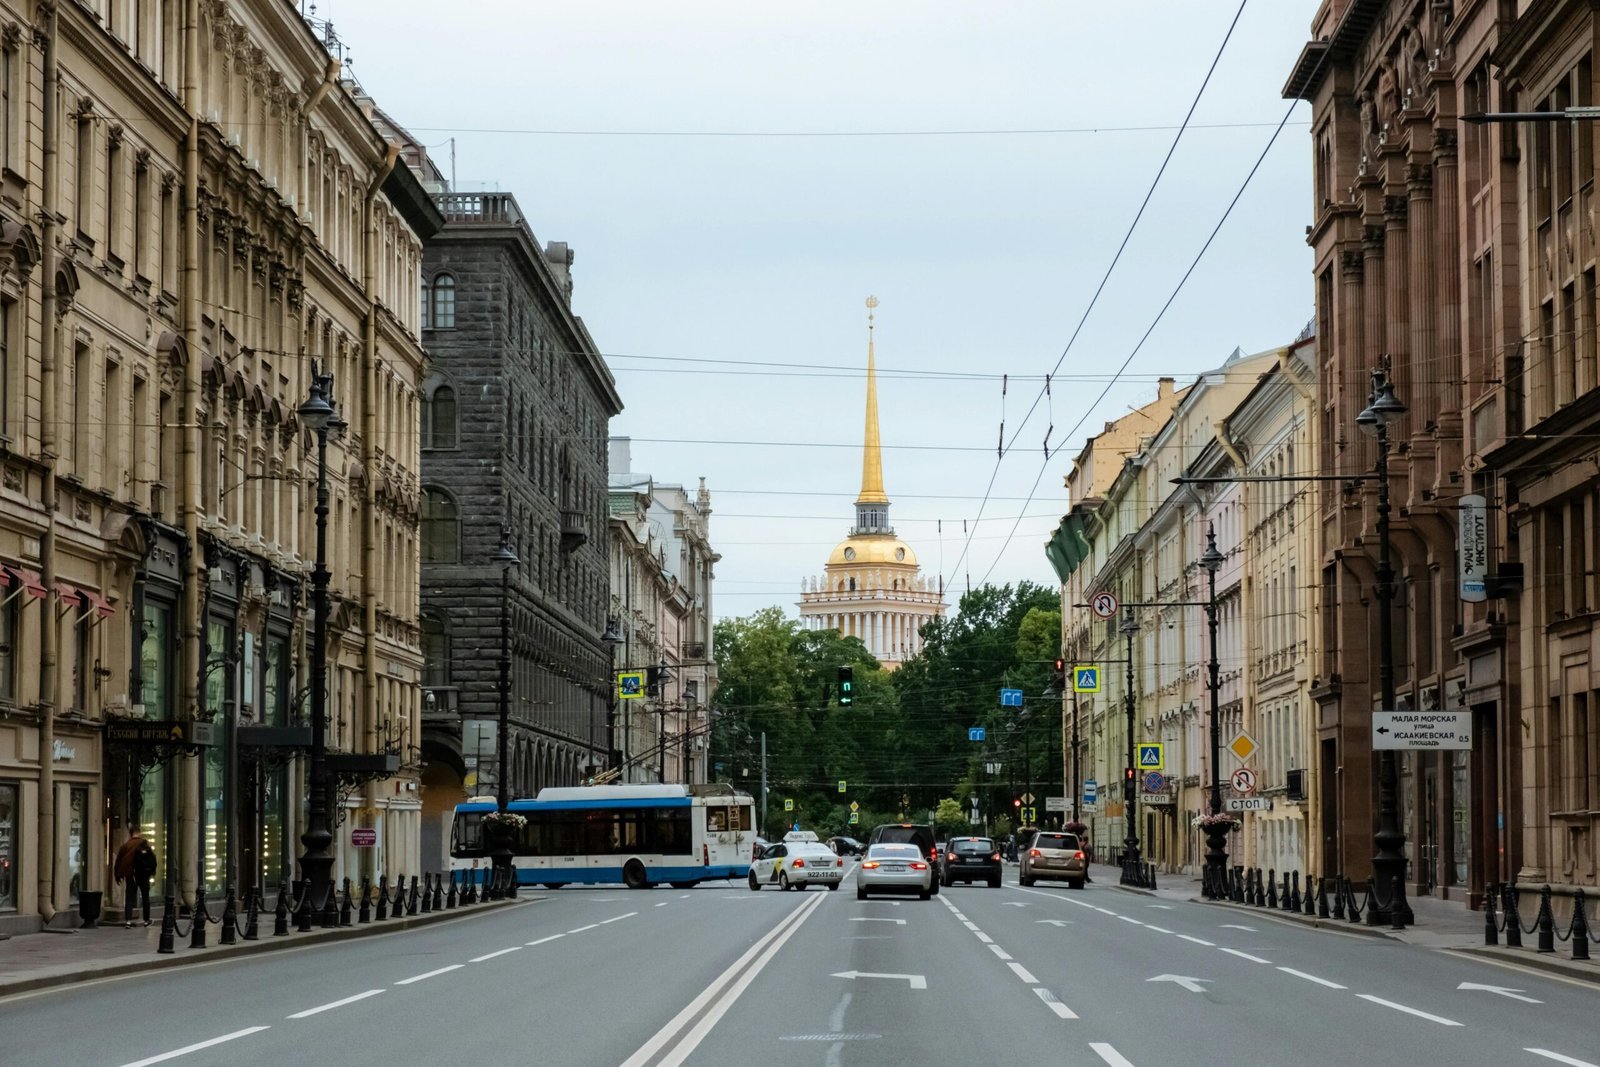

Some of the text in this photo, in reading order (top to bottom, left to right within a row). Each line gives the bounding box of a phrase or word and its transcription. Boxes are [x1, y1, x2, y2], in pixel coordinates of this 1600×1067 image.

[1475, 515, 1485, 566] ИНСТИТУТ
[1391, 715, 1457, 723] МАЛАЯ МОРСКАЯ
[1413, 723, 1435, 731] улица
[1394, 732, 1455, 740] ИСААКИЕВСКАЯ
[1143, 795, 1166, 803] СТОП
[1230, 799, 1261, 810] СТОП
